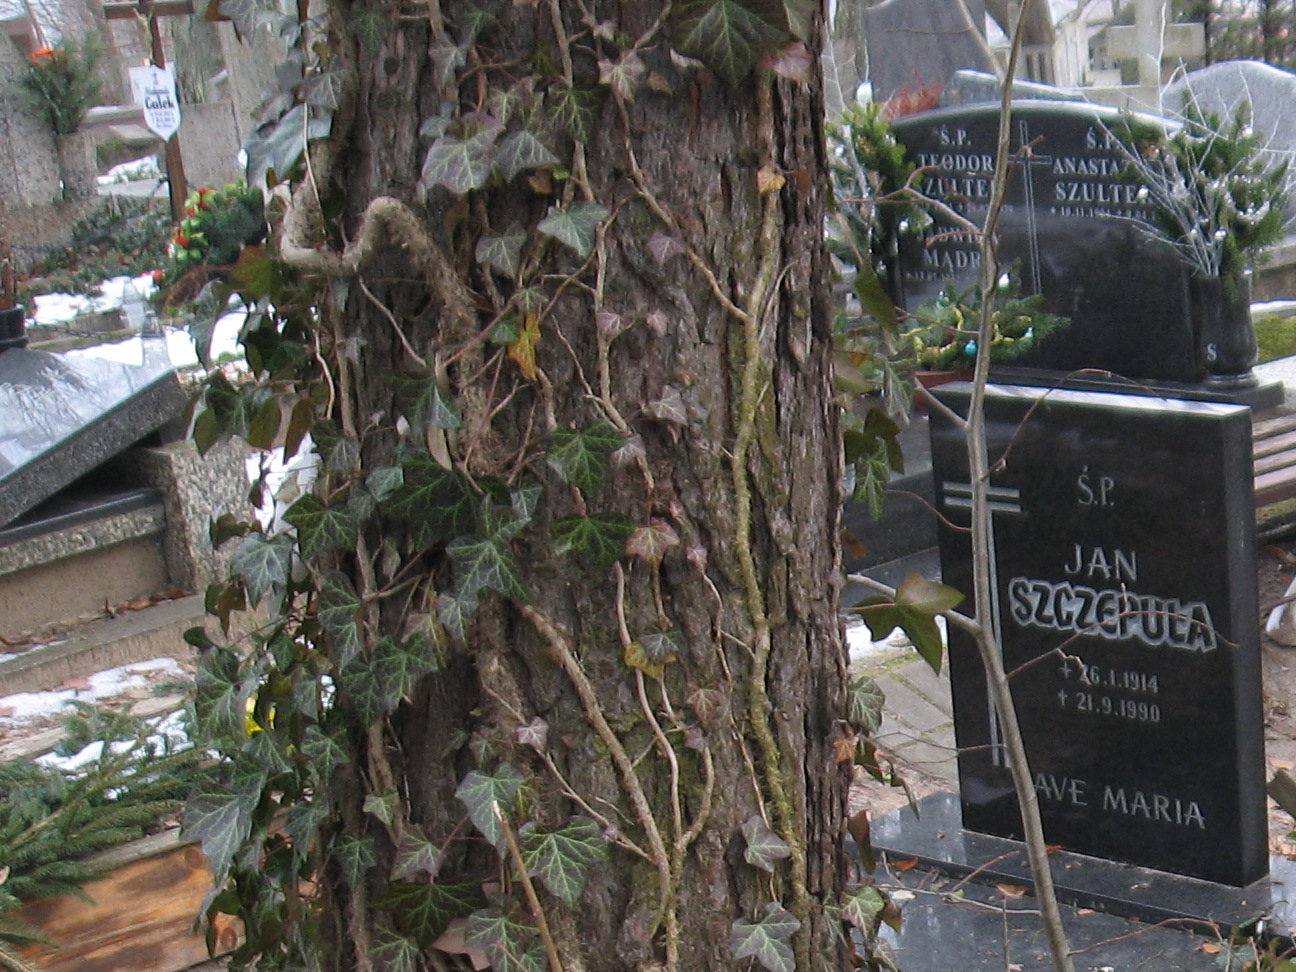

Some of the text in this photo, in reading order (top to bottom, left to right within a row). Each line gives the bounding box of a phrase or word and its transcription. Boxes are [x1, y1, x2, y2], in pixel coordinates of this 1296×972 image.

[917, 153, 994, 172] TEODOR
[919, 178, 995, 197] ZULTE
[1055, 182, 1156, 203] SZULTE
[923, 248, 982, 273] MĄDR
[1077, 465, 1116, 507] Ś.P.
[1064, 543, 1138, 582] JAN
[1008, 576, 1218, 653] SZCZEPUŁA
[1080, 663, 1159, 694] 26.1.1914
[1076, 691, 1161, 723] 21.9.1990
[1033, 772, 1207, 830] AVE MARIA
